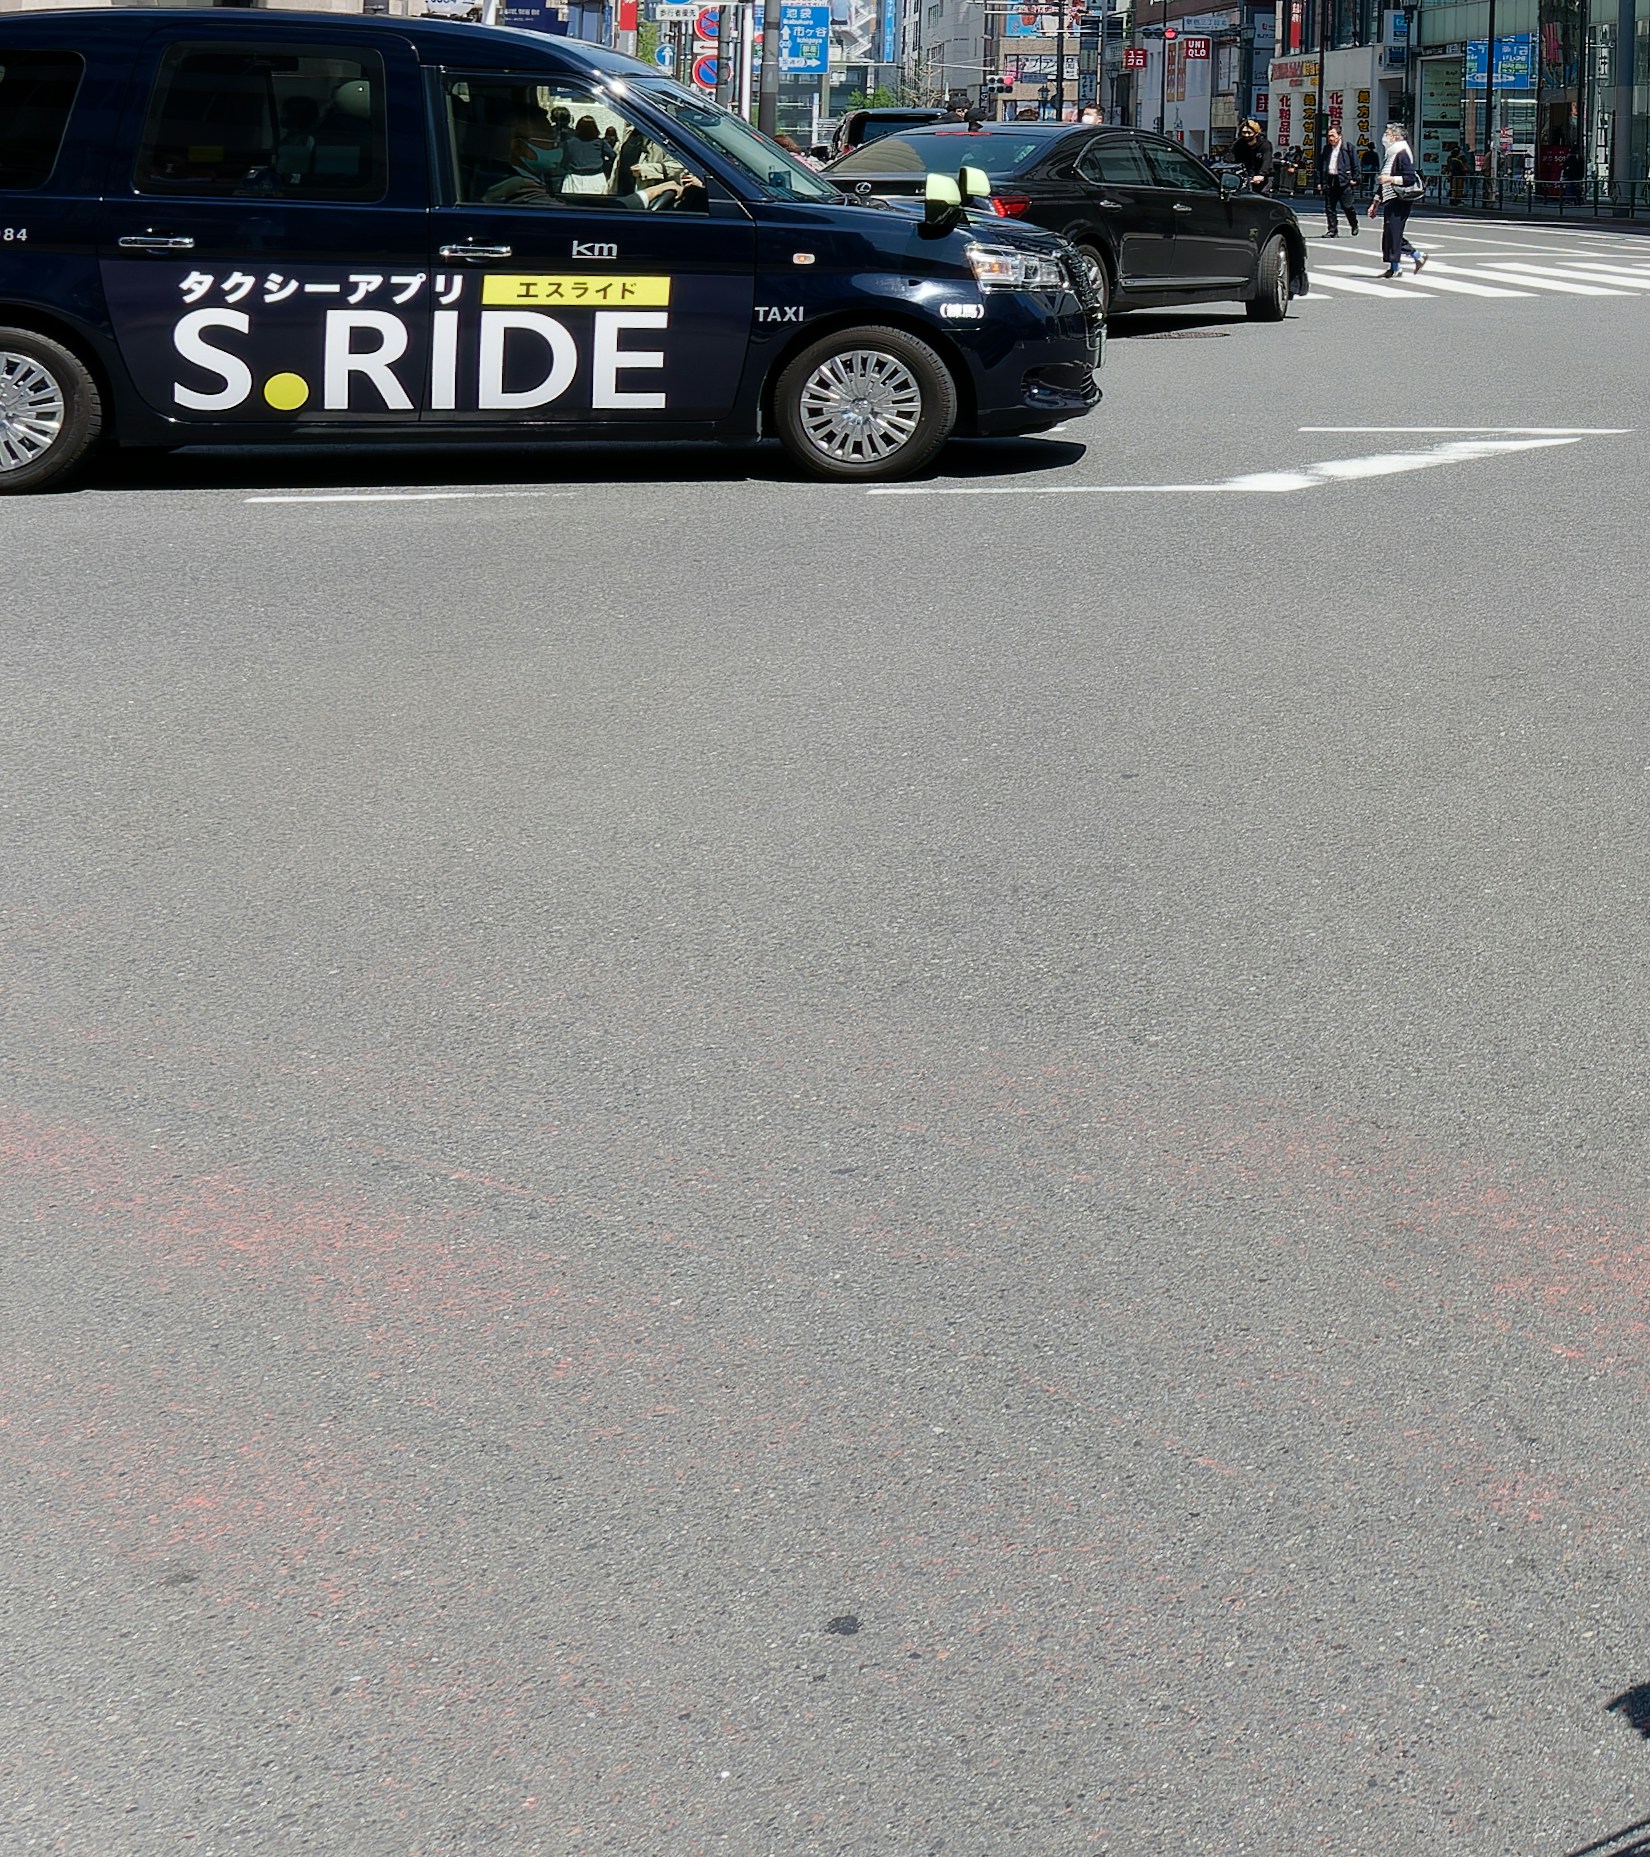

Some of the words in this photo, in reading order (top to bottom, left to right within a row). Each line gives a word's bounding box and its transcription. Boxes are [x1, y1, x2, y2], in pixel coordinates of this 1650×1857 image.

[785, 7, 812, 19] 池袋
[1187, 49, 1207, 58] QLO
[1188, 41, 1206, 49] UNI
[177, 270, 465, 306] タクシーアプリ
[515, 280, 638, 300] エスライド
[753, 305, 806, 322] TAXI
[172, 309, 669, 411] S.RIDE
